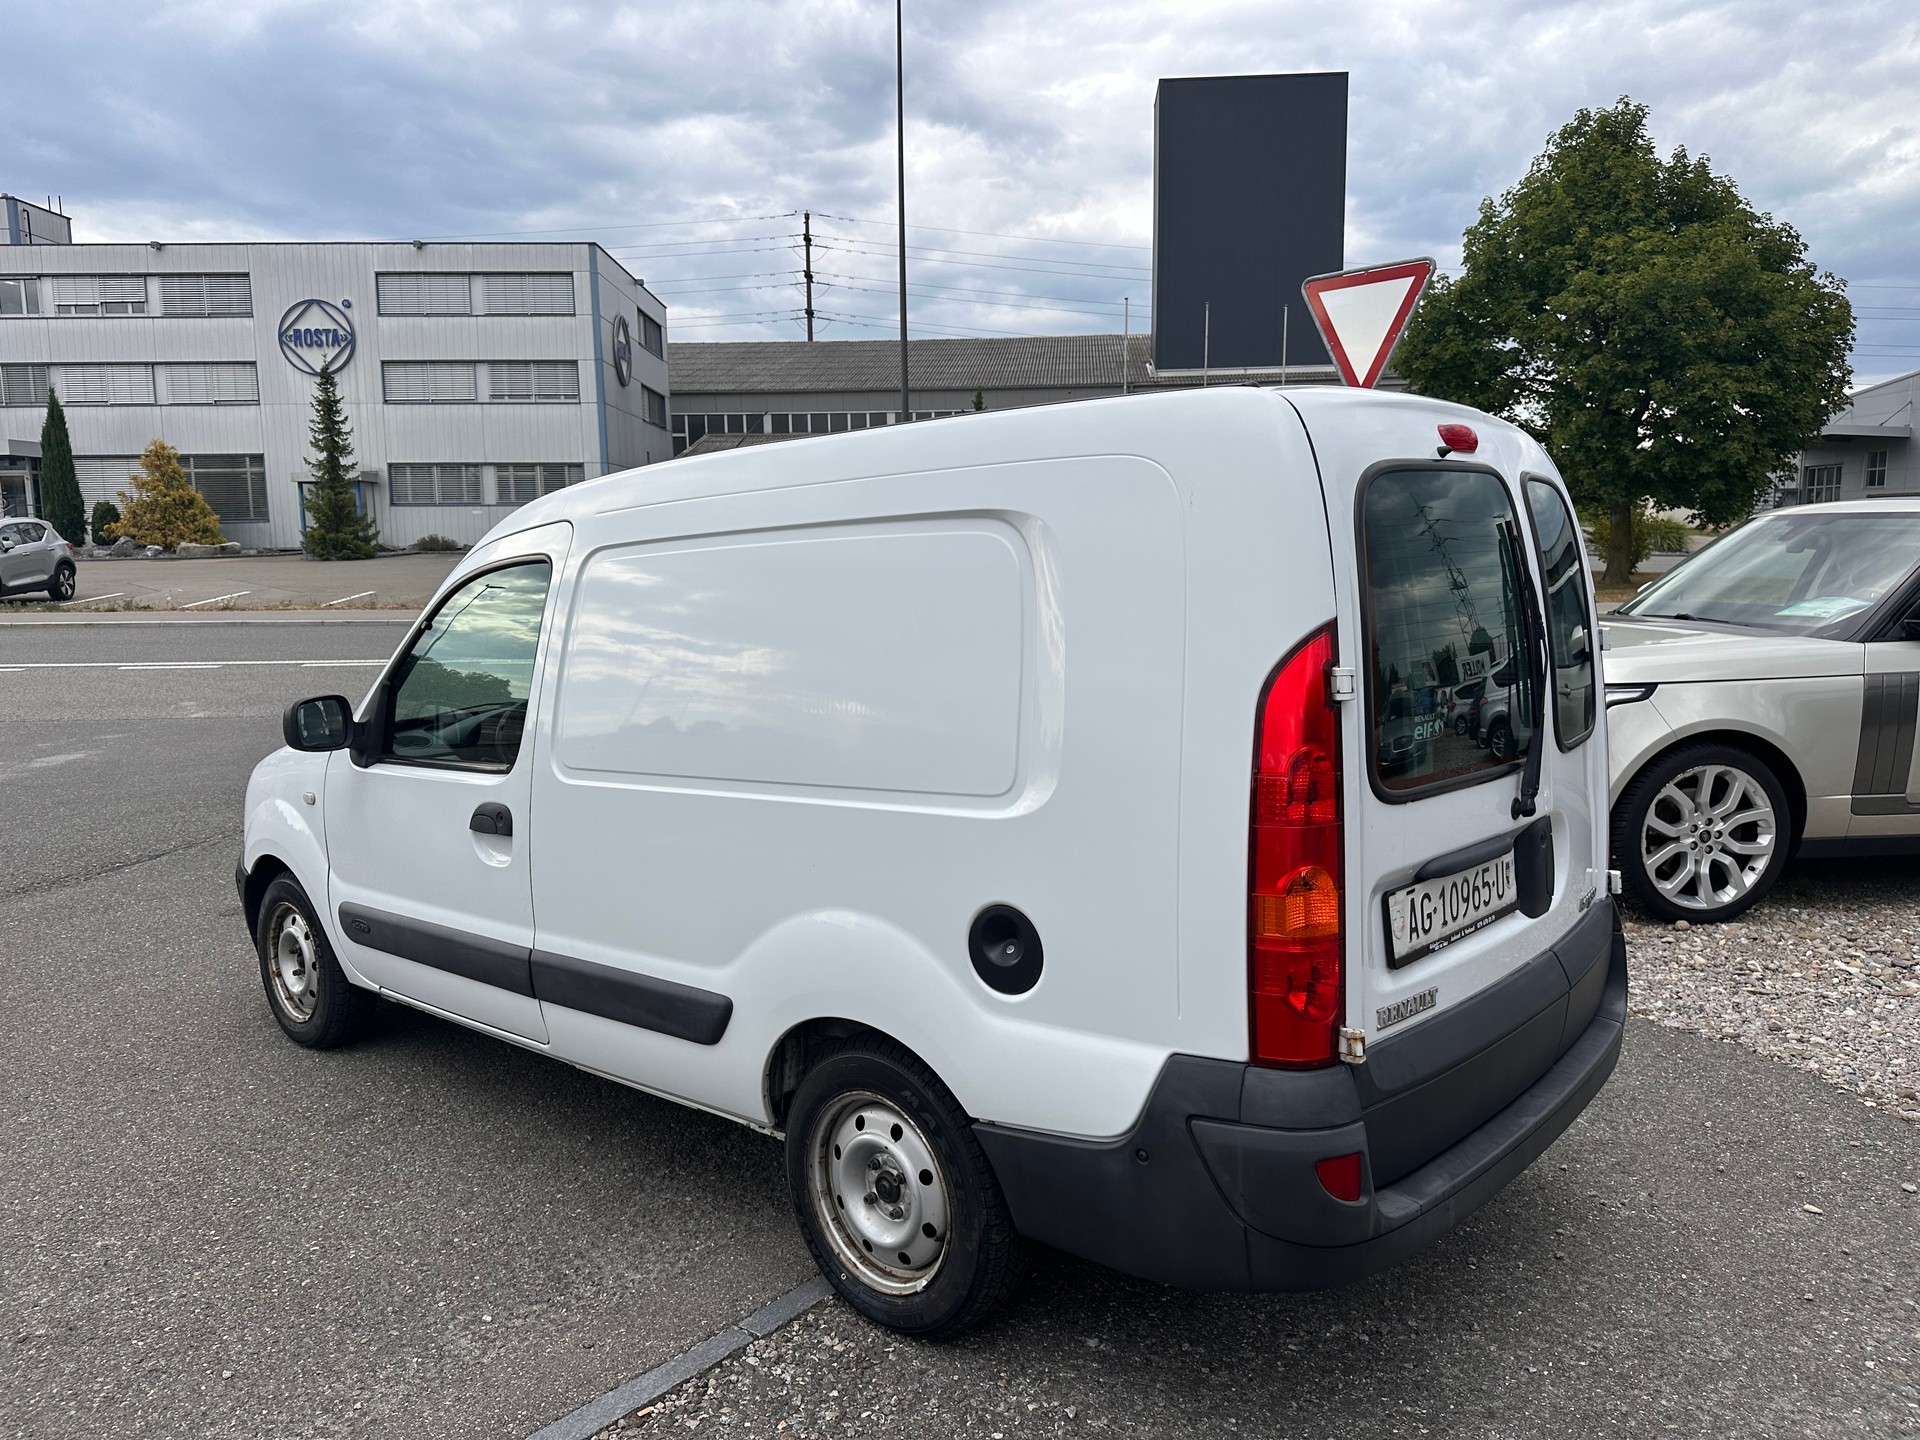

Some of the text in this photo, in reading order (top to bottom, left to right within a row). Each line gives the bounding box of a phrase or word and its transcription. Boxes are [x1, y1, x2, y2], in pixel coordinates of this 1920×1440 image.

[293, 328, 341, 347] ROSTA
[1414, 722, 1433, 739] elf
[1376, 986, 1438, 1031] RENAULT
